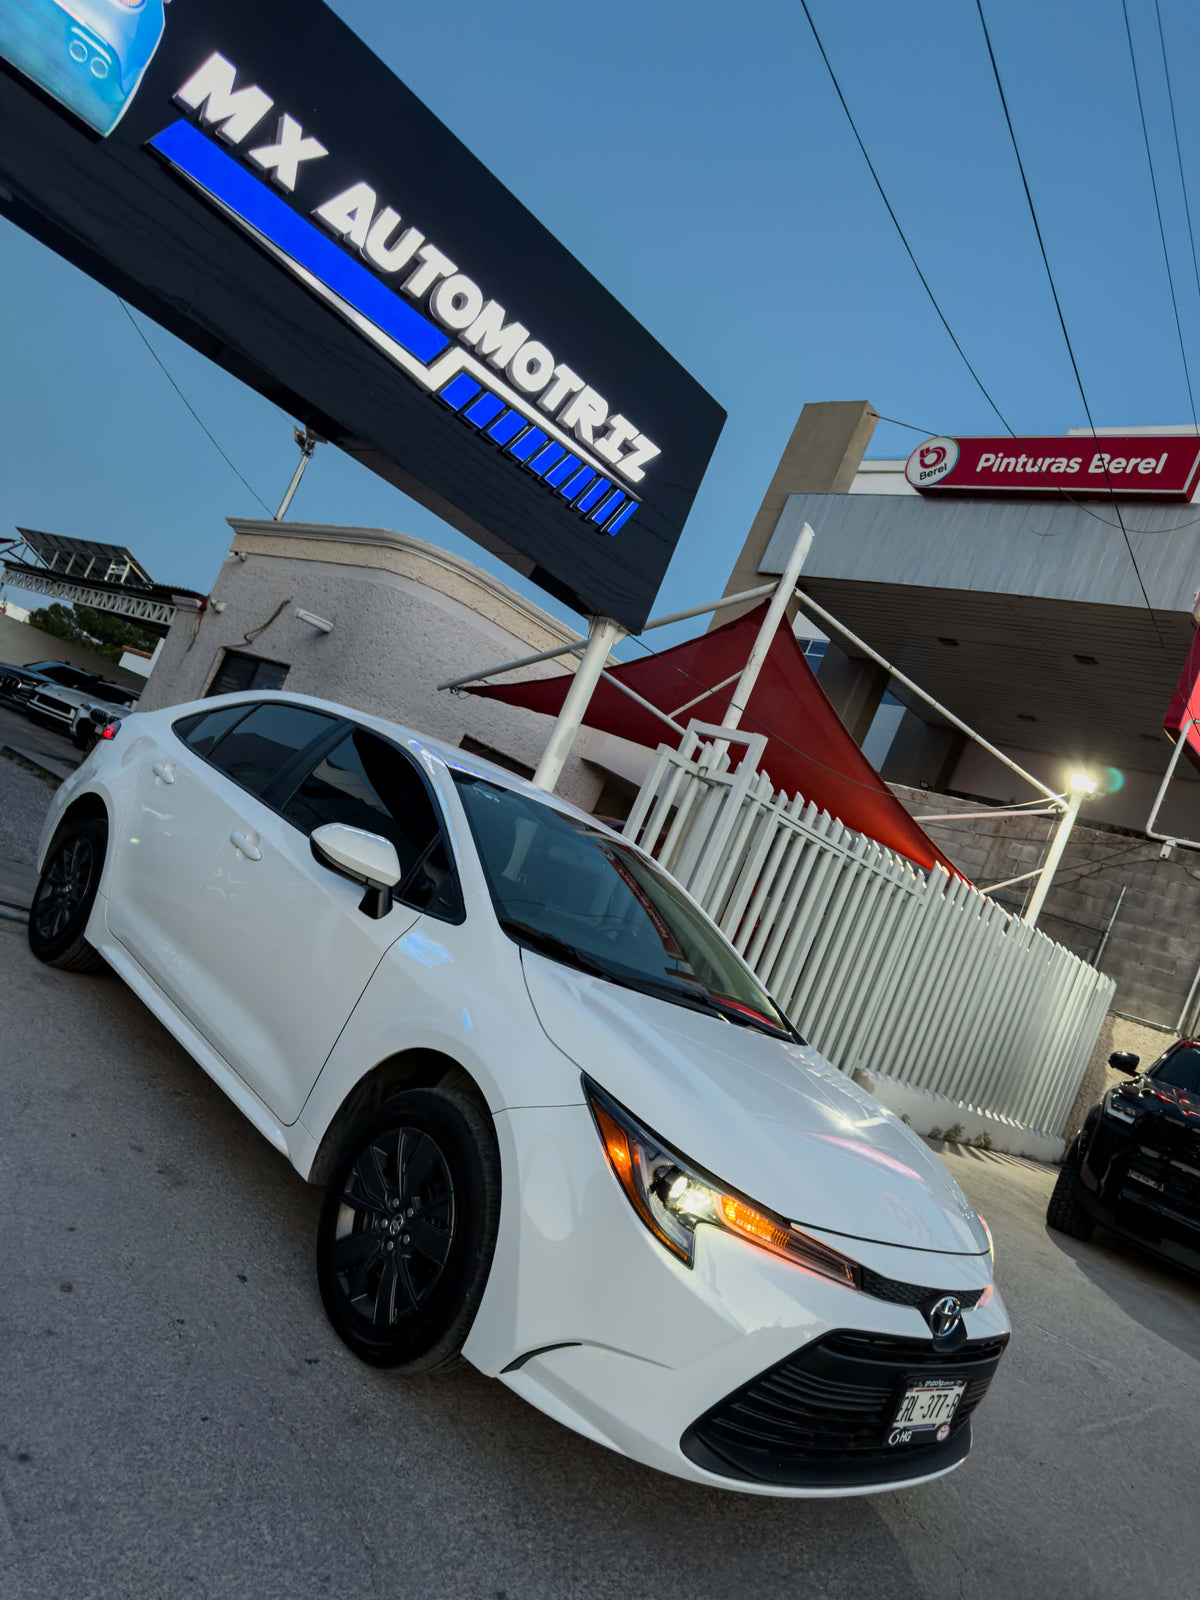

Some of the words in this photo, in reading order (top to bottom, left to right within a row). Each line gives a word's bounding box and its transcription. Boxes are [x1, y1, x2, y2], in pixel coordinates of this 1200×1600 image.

[172, 51, 329, 192] MX
[311, 181, 662, 483] AUTOMOTRIZ
[919, 463, 947, 480] Berel
[975, 453, 1082, 474] Pinturas
[1088, 452, 1168, 475] Berel
